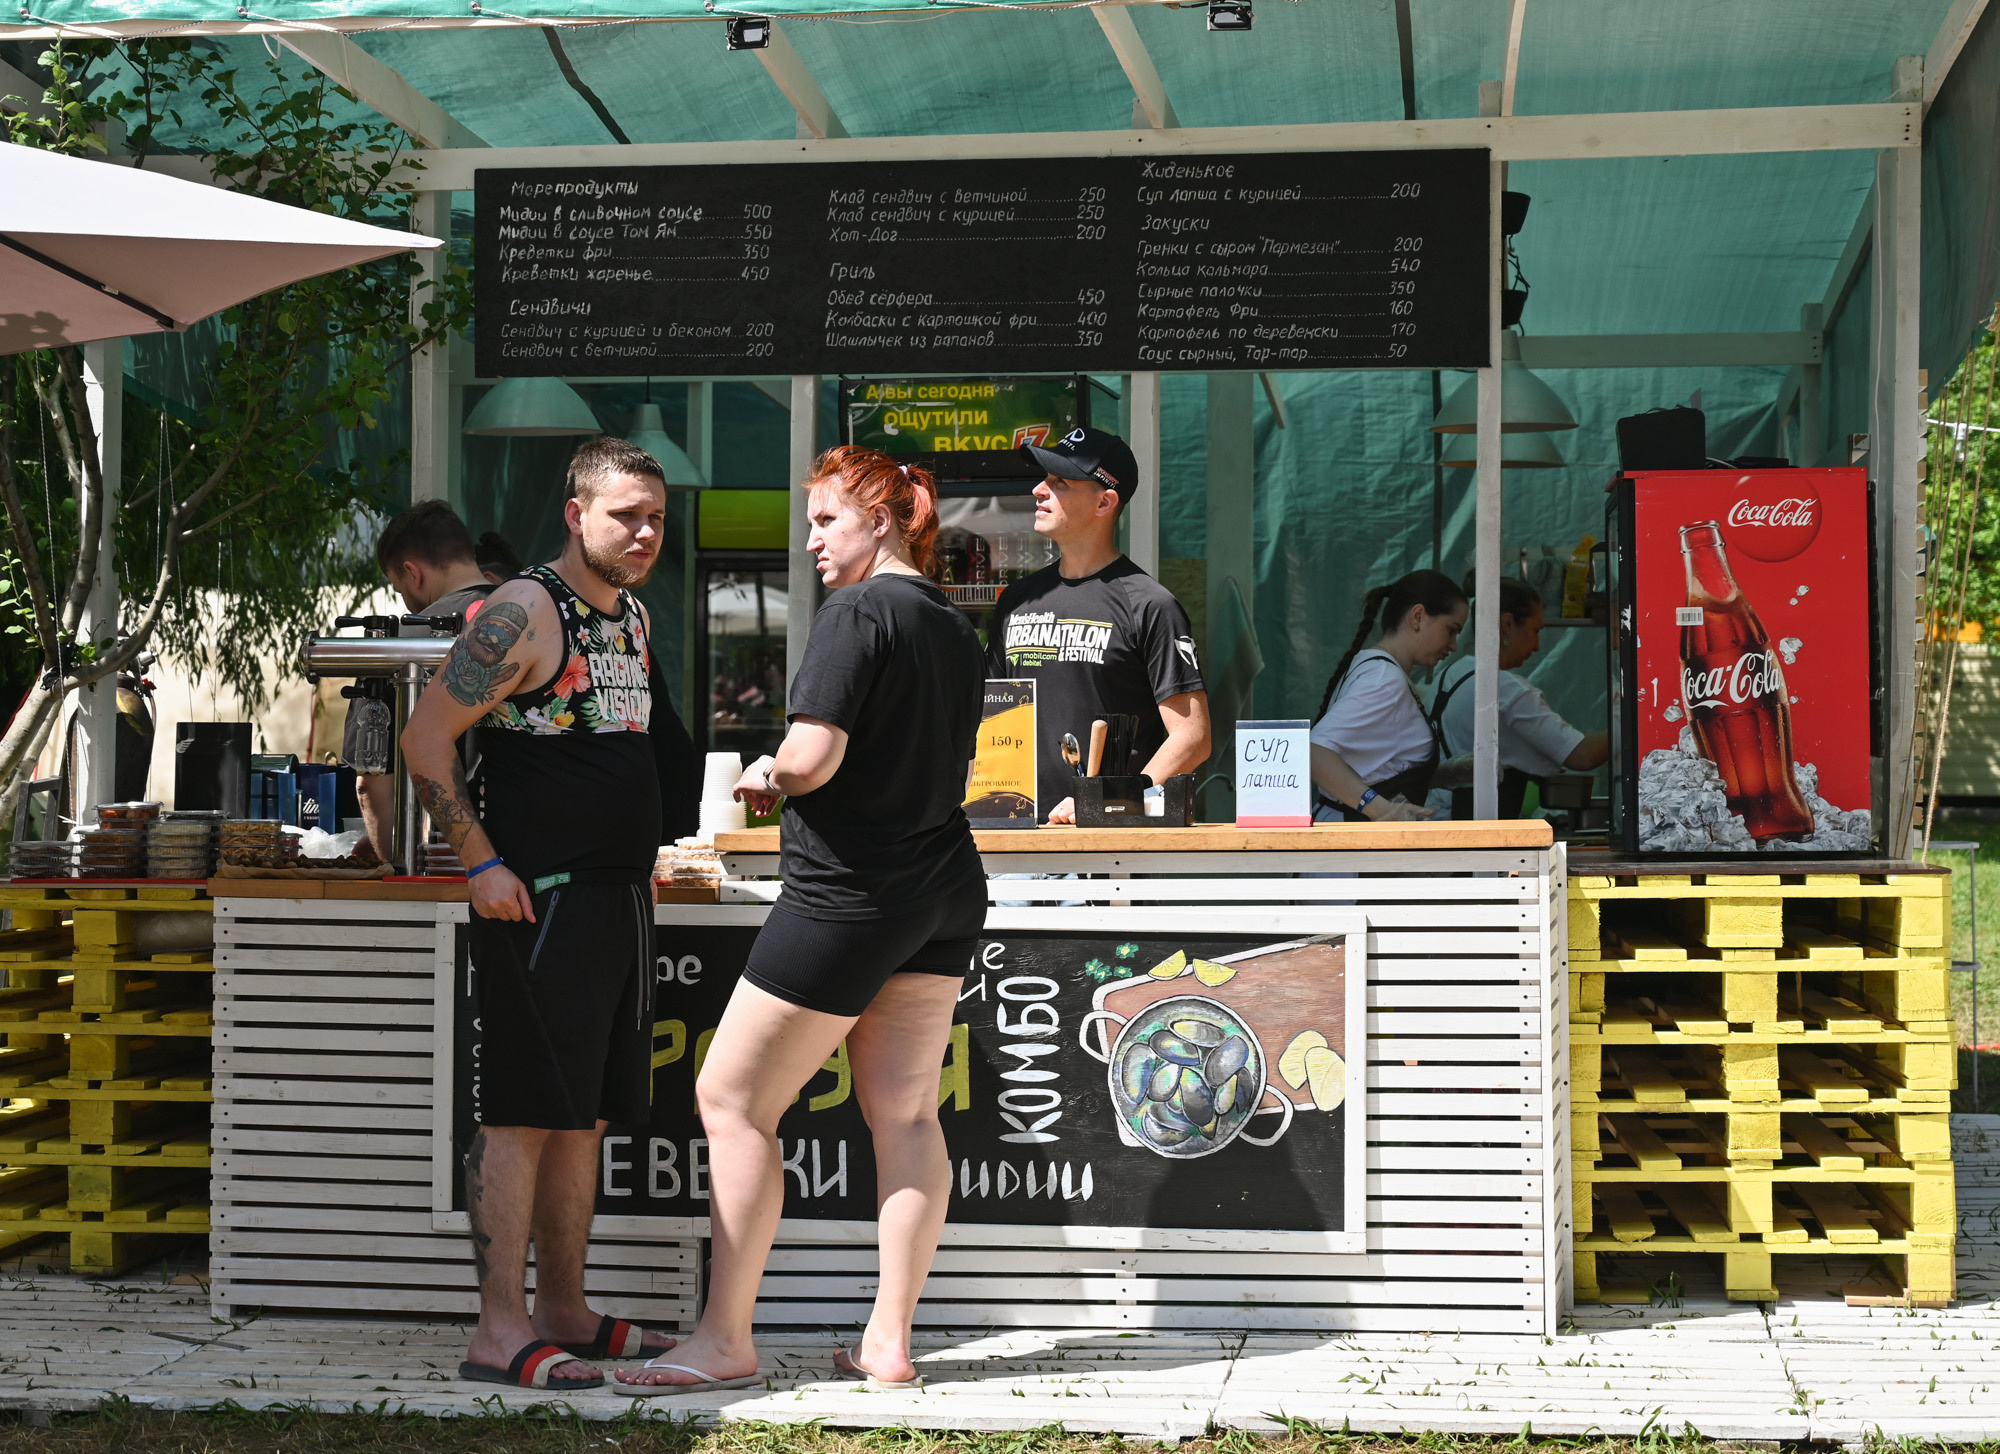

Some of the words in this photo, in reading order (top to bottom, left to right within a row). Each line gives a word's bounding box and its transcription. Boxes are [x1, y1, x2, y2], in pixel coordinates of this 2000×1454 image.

[1142, 161, 1235, 179] Жиденькое
[511, 180, 639, 199] Морепродукты
[872, 188, 932, 204] сендвич
[940, 190, 947, 204] с
[954, 187, 1027, 204] ветчиной
[1078, 187, 1106, 202] 250
[1137, 186, 1163, 205] Суп
[1169, 187, 1217, 202] лапша
[1224, 188, 1232, 200] с
[1239, 185, 1301, 203] курицей
[1391, 182, 1421, 198] 200
[500, 206, 547, 222] Мидии
[569, 205, 650, 222] сливочном
[658, 206, 703, 223] соусе
[744, 204, 772, 219] 500
[871, 206, 931, 223] сендвич
[939, 210, 947, 222] с
[953, 207, 1015, 226] курицей
[1077, 205, 1105, 220] 250
[499, 224, 547, 240] Мидии
[569, 225, 614, 243] соусе
[621, 224, 650, 239] Том
[654, 223, 677, 240] Ям
[744, 224, 772, 240] 550
[829, 227, 898, 243] Хот-Дог
[1077, 225, 1106, 240] 200
[1140, 214, 1210, 235] Закуски
[499, 244, 575, 264] Креветки
[582, 245, 612, 262] фри
[743, 244, 770, 260] 350
[1137, 240, 1188, 257] Гренки
[1195, 243, 1202, 255] с
[1210, 242, 1255, 256] сыром
[1394, 237, 1423, 252] 200
[502, 264, 579, 283] Креветки
[741, 266, 770, 281] 450
[829, 262, 876, 281] Гриль
[1136, 261, 1190, 277] Кольца
[1196, 264, 1269, 280] кальмара
[1391, 258, 1420, 273] 540
[827, 290, 864, 306] Обед
[1077, 289, 1105, 305] 450
[1139, 284, 1193, 300] Сырные
[1200, 284, 1262, 298] палочки
[1389, 280, 1415, 295] 350
[510, 298, 591, 316] Сендвичи
[1137, 302, 1220, 319] Картофель
[1390, 300, 1413, 315] 160
[825, 310, 896, 328] Колбаски
[902, 315, 911, 327] с
[917, 311, 1001, 329] картошкой
[1008, 313, 1037, 328] фри
[1077, 312, 1107, 326] 400
[501, 323, 562, 340] Сендвич
[569, 326, 577, 338] с
[653, 325, 662, 338] и
[668, 323, 731, 338] беконом
[745, 323, 774, 338] 200
[826, 332, 903, 348] Шашлычек
[910, 335, 927, 348] из
[932, 331, 995, 348] рапанов
[1074, 330, 1103, 347] 350
[1138, 325, 1220, 342] Картофель
[1228, 327, 1246, 339] по
[1253, 323, 1338, 340] деревенски
[1391, 322, 1416, 337] 170
[502, 342, 563, 358] Сендвич
[570, 345, 578, 358] с
[585, 342, 657, 358] ветчиной
[745, 342, 774, 357] 200
[1138, 345, 1172, 364] Соус
[1388, 343, 1407, 358] 50
[866, 384, 879, 399] А
[885, 385, 913, 399] вы
[917, 384, 995, 400] сегодня
[884, 409, 988, 430] ощутили
[1728, 498, 1817, 528] Coca-Cola
[1005, 624, 1112, 650] URBANATHLON
[1065, 646, 1105, 665] FESTIVAL
[1681, 652, 1783, 709] Coca-Cola
[991, 736, 1012, 747] 150
[1242, 773, 1300, 789] лапша
[997, 976, 1062, 1143] КОМБО
